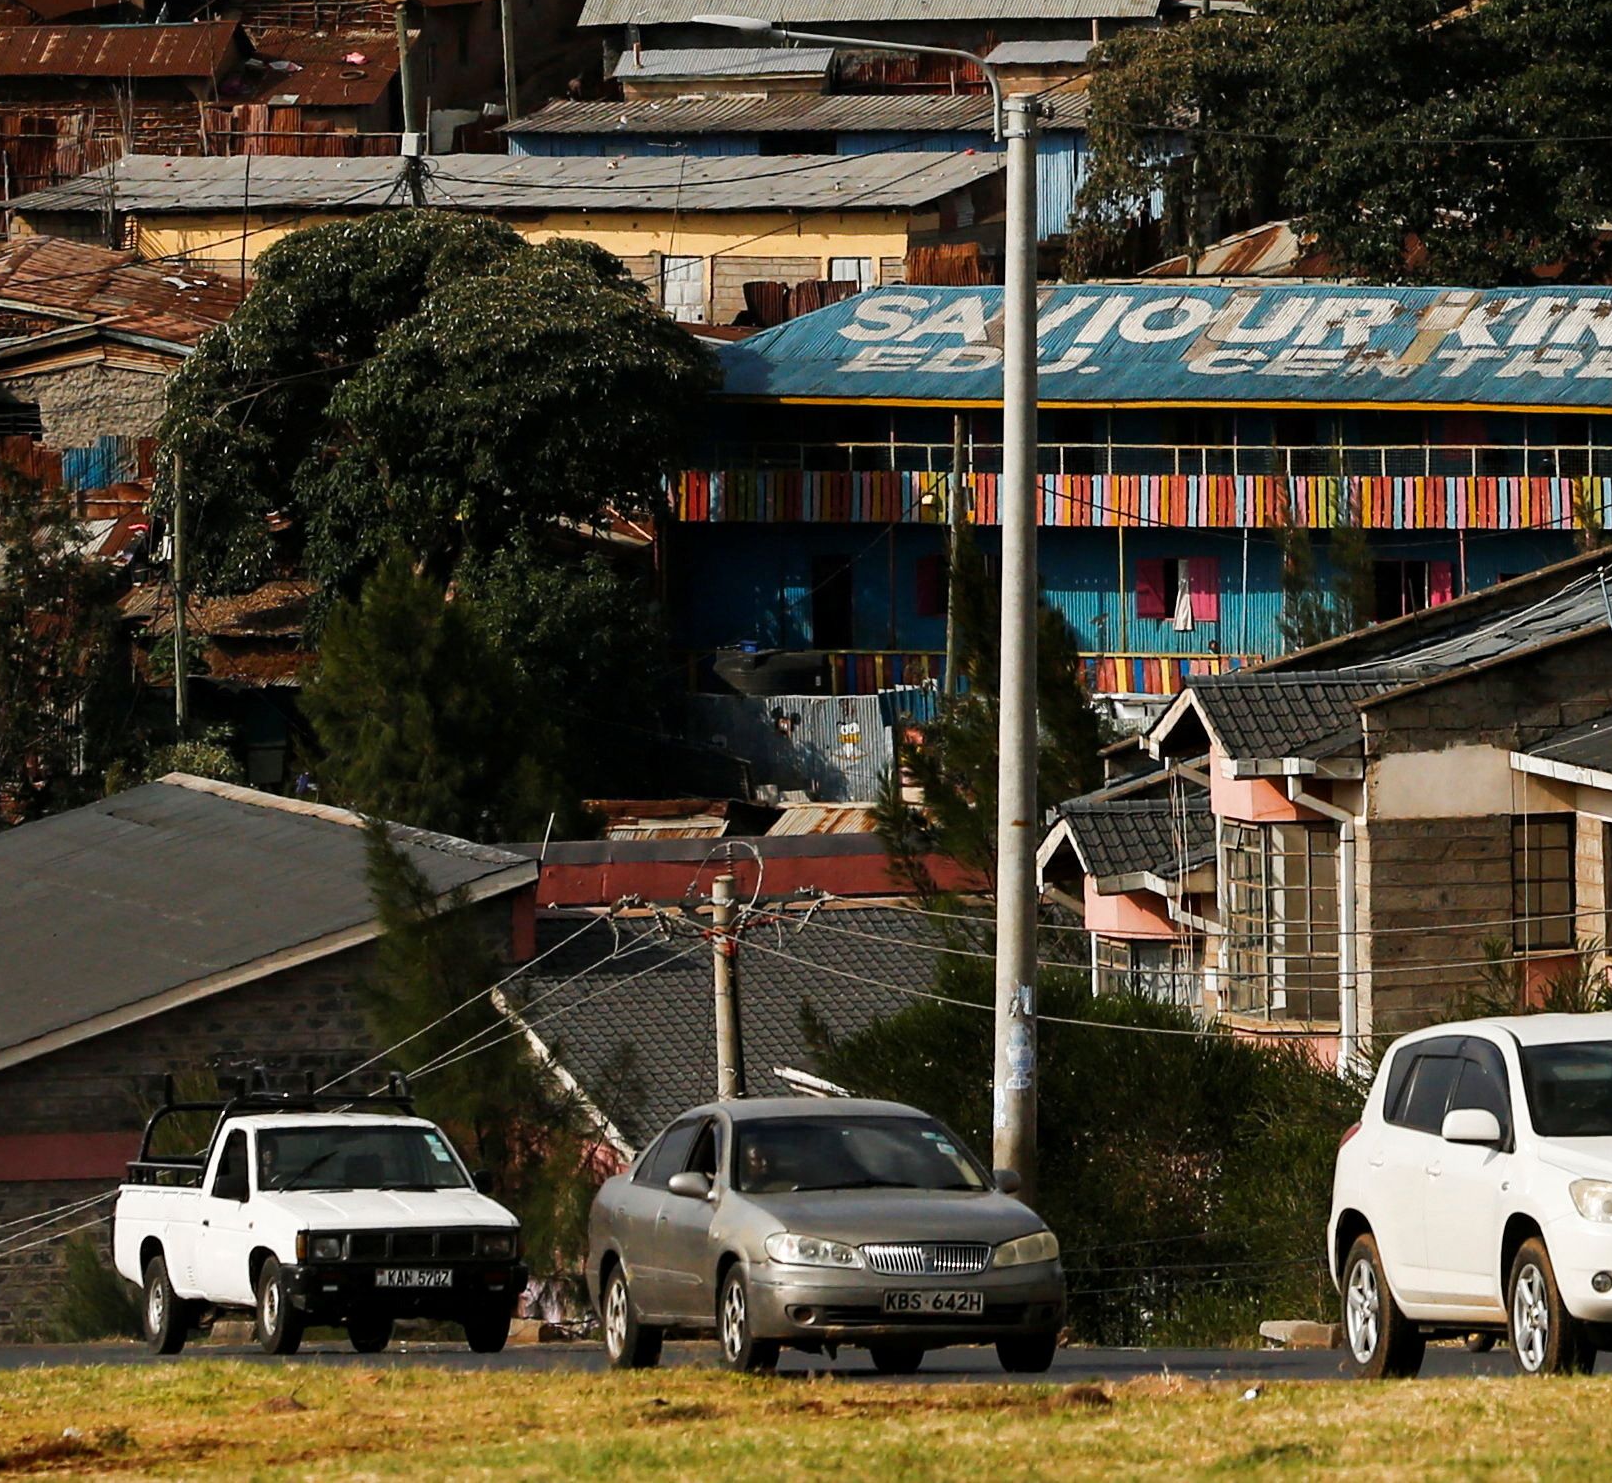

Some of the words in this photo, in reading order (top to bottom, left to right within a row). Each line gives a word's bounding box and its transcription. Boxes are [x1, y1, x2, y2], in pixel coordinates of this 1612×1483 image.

[837, 293, 1399, 347] SAVIOUR
[886, 1293, 921, 1310] KBS
[932, 1293, 982, 1311] 642H
